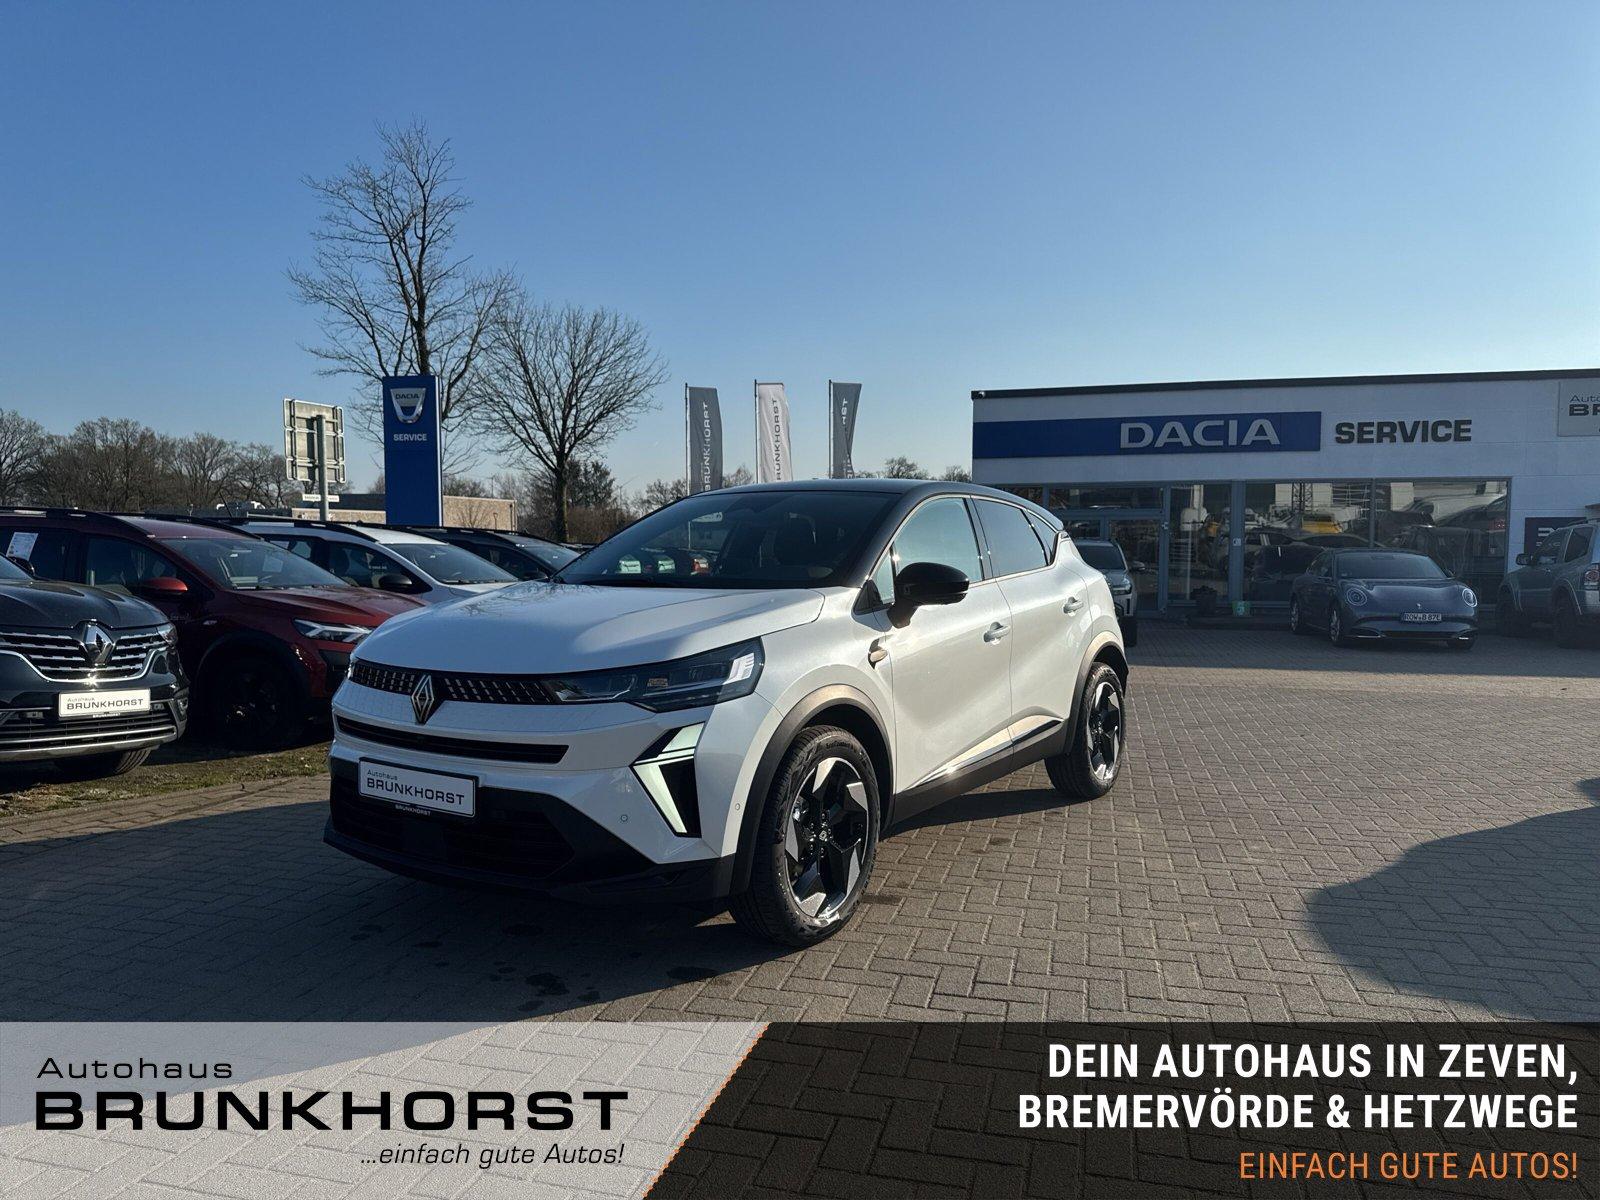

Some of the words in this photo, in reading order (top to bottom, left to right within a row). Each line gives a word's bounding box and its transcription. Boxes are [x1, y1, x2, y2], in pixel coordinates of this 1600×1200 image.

[393, 433, 427, 442] SERVICE
[772, 399, 782, 480] RUNKHORST
[1119, 418, 1281, 449] DACIA
[1335, 418, 1472, 444] SERVICE
[66, 699, 144, 710] BRUNKHORST
[367, 769, 398, 781] Autohaus
[367, 777, 465, 805] BRUNKHORST
